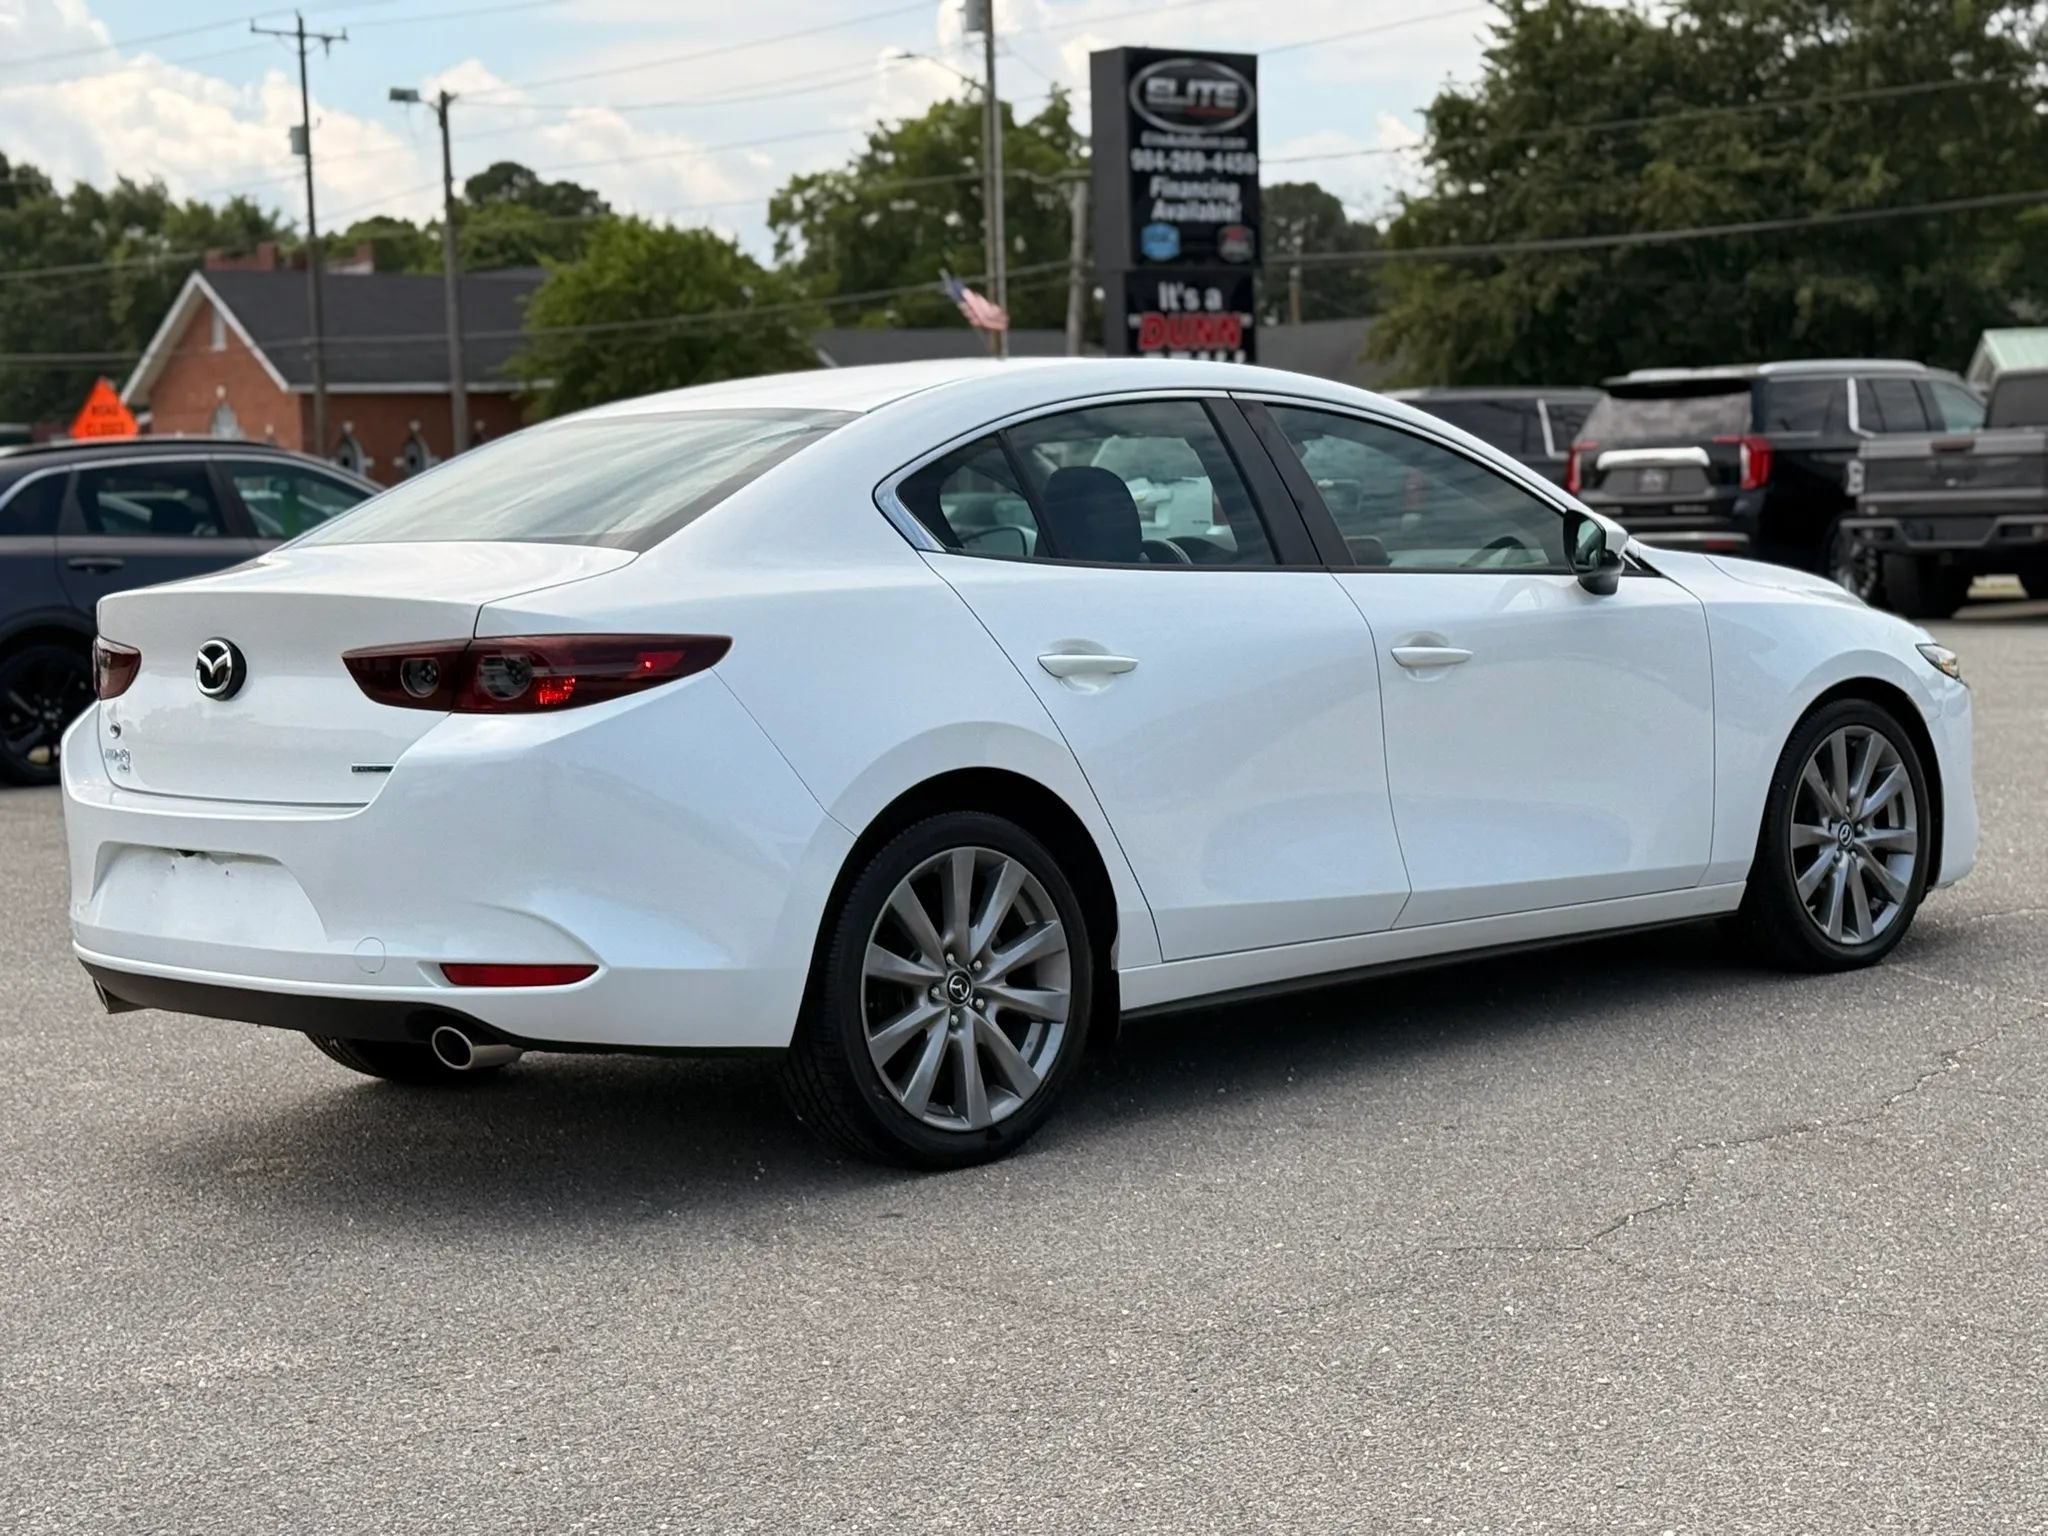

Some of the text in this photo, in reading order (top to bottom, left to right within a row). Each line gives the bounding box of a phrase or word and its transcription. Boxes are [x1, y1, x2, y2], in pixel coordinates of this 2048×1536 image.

[1146, 78, 1239, 107] ELITE
[1149, 176, 1240, 203] Financing
[1158, 281, 1222, 311] It's a
